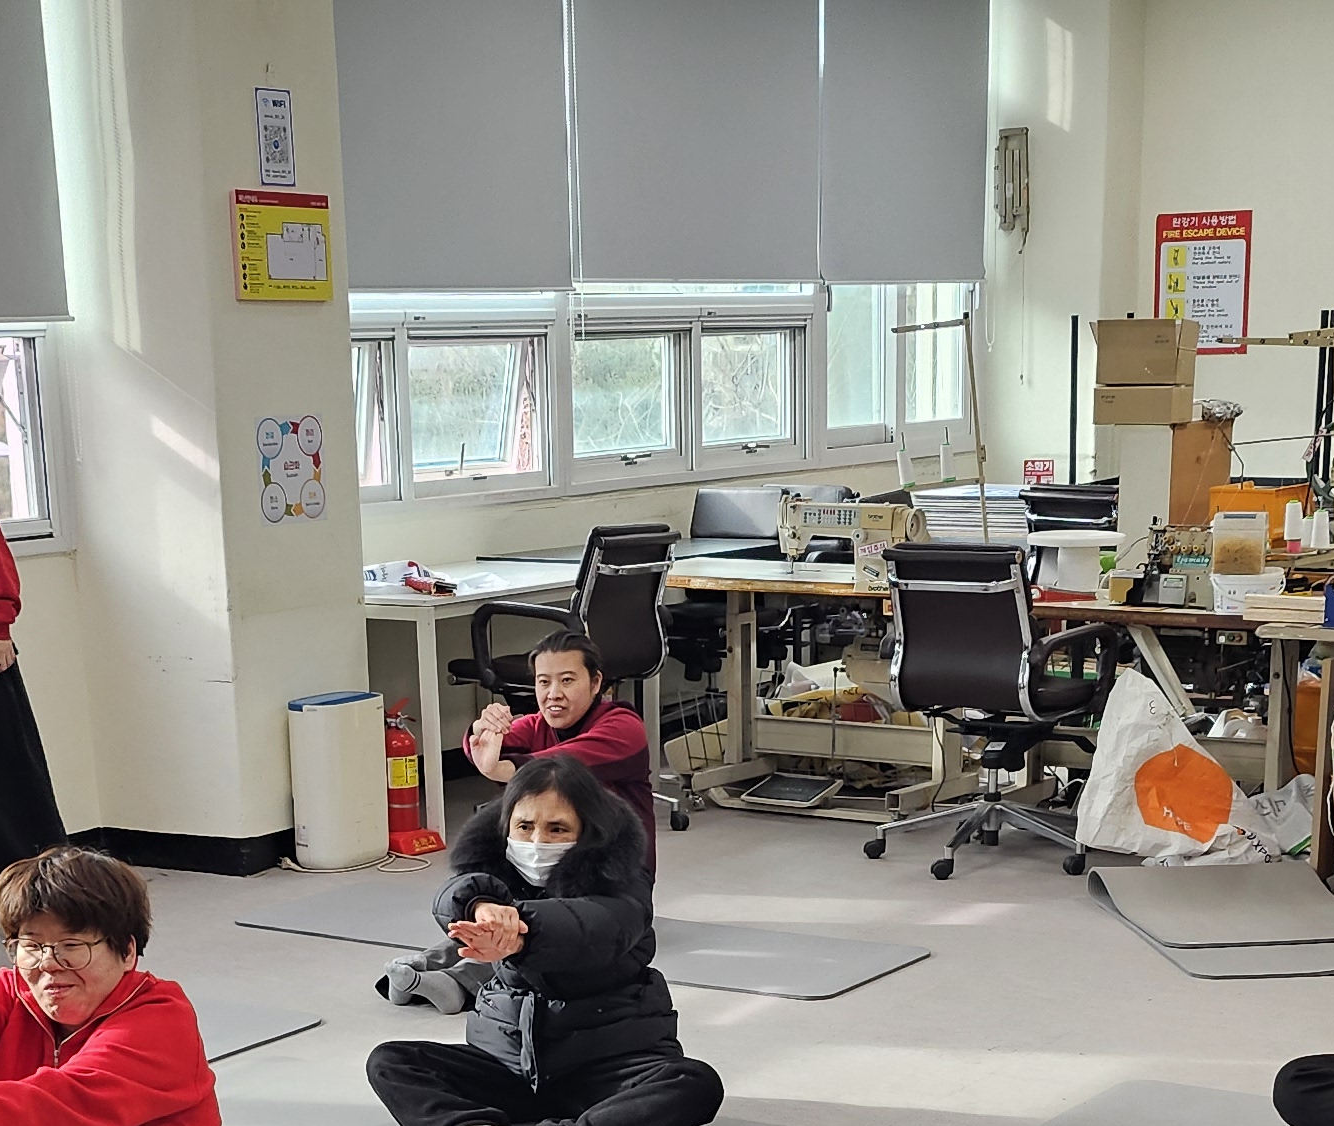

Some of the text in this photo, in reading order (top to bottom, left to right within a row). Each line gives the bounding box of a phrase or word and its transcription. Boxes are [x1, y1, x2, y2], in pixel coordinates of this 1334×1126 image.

[1201, 215, 1237, 226] 사용방법
[1162, 227, 1246, 239] FIRE ESCAPE DEVICE
[1025, 461, 1053, 471] 소화기
[1162, 806, 1192, 832] HPE
